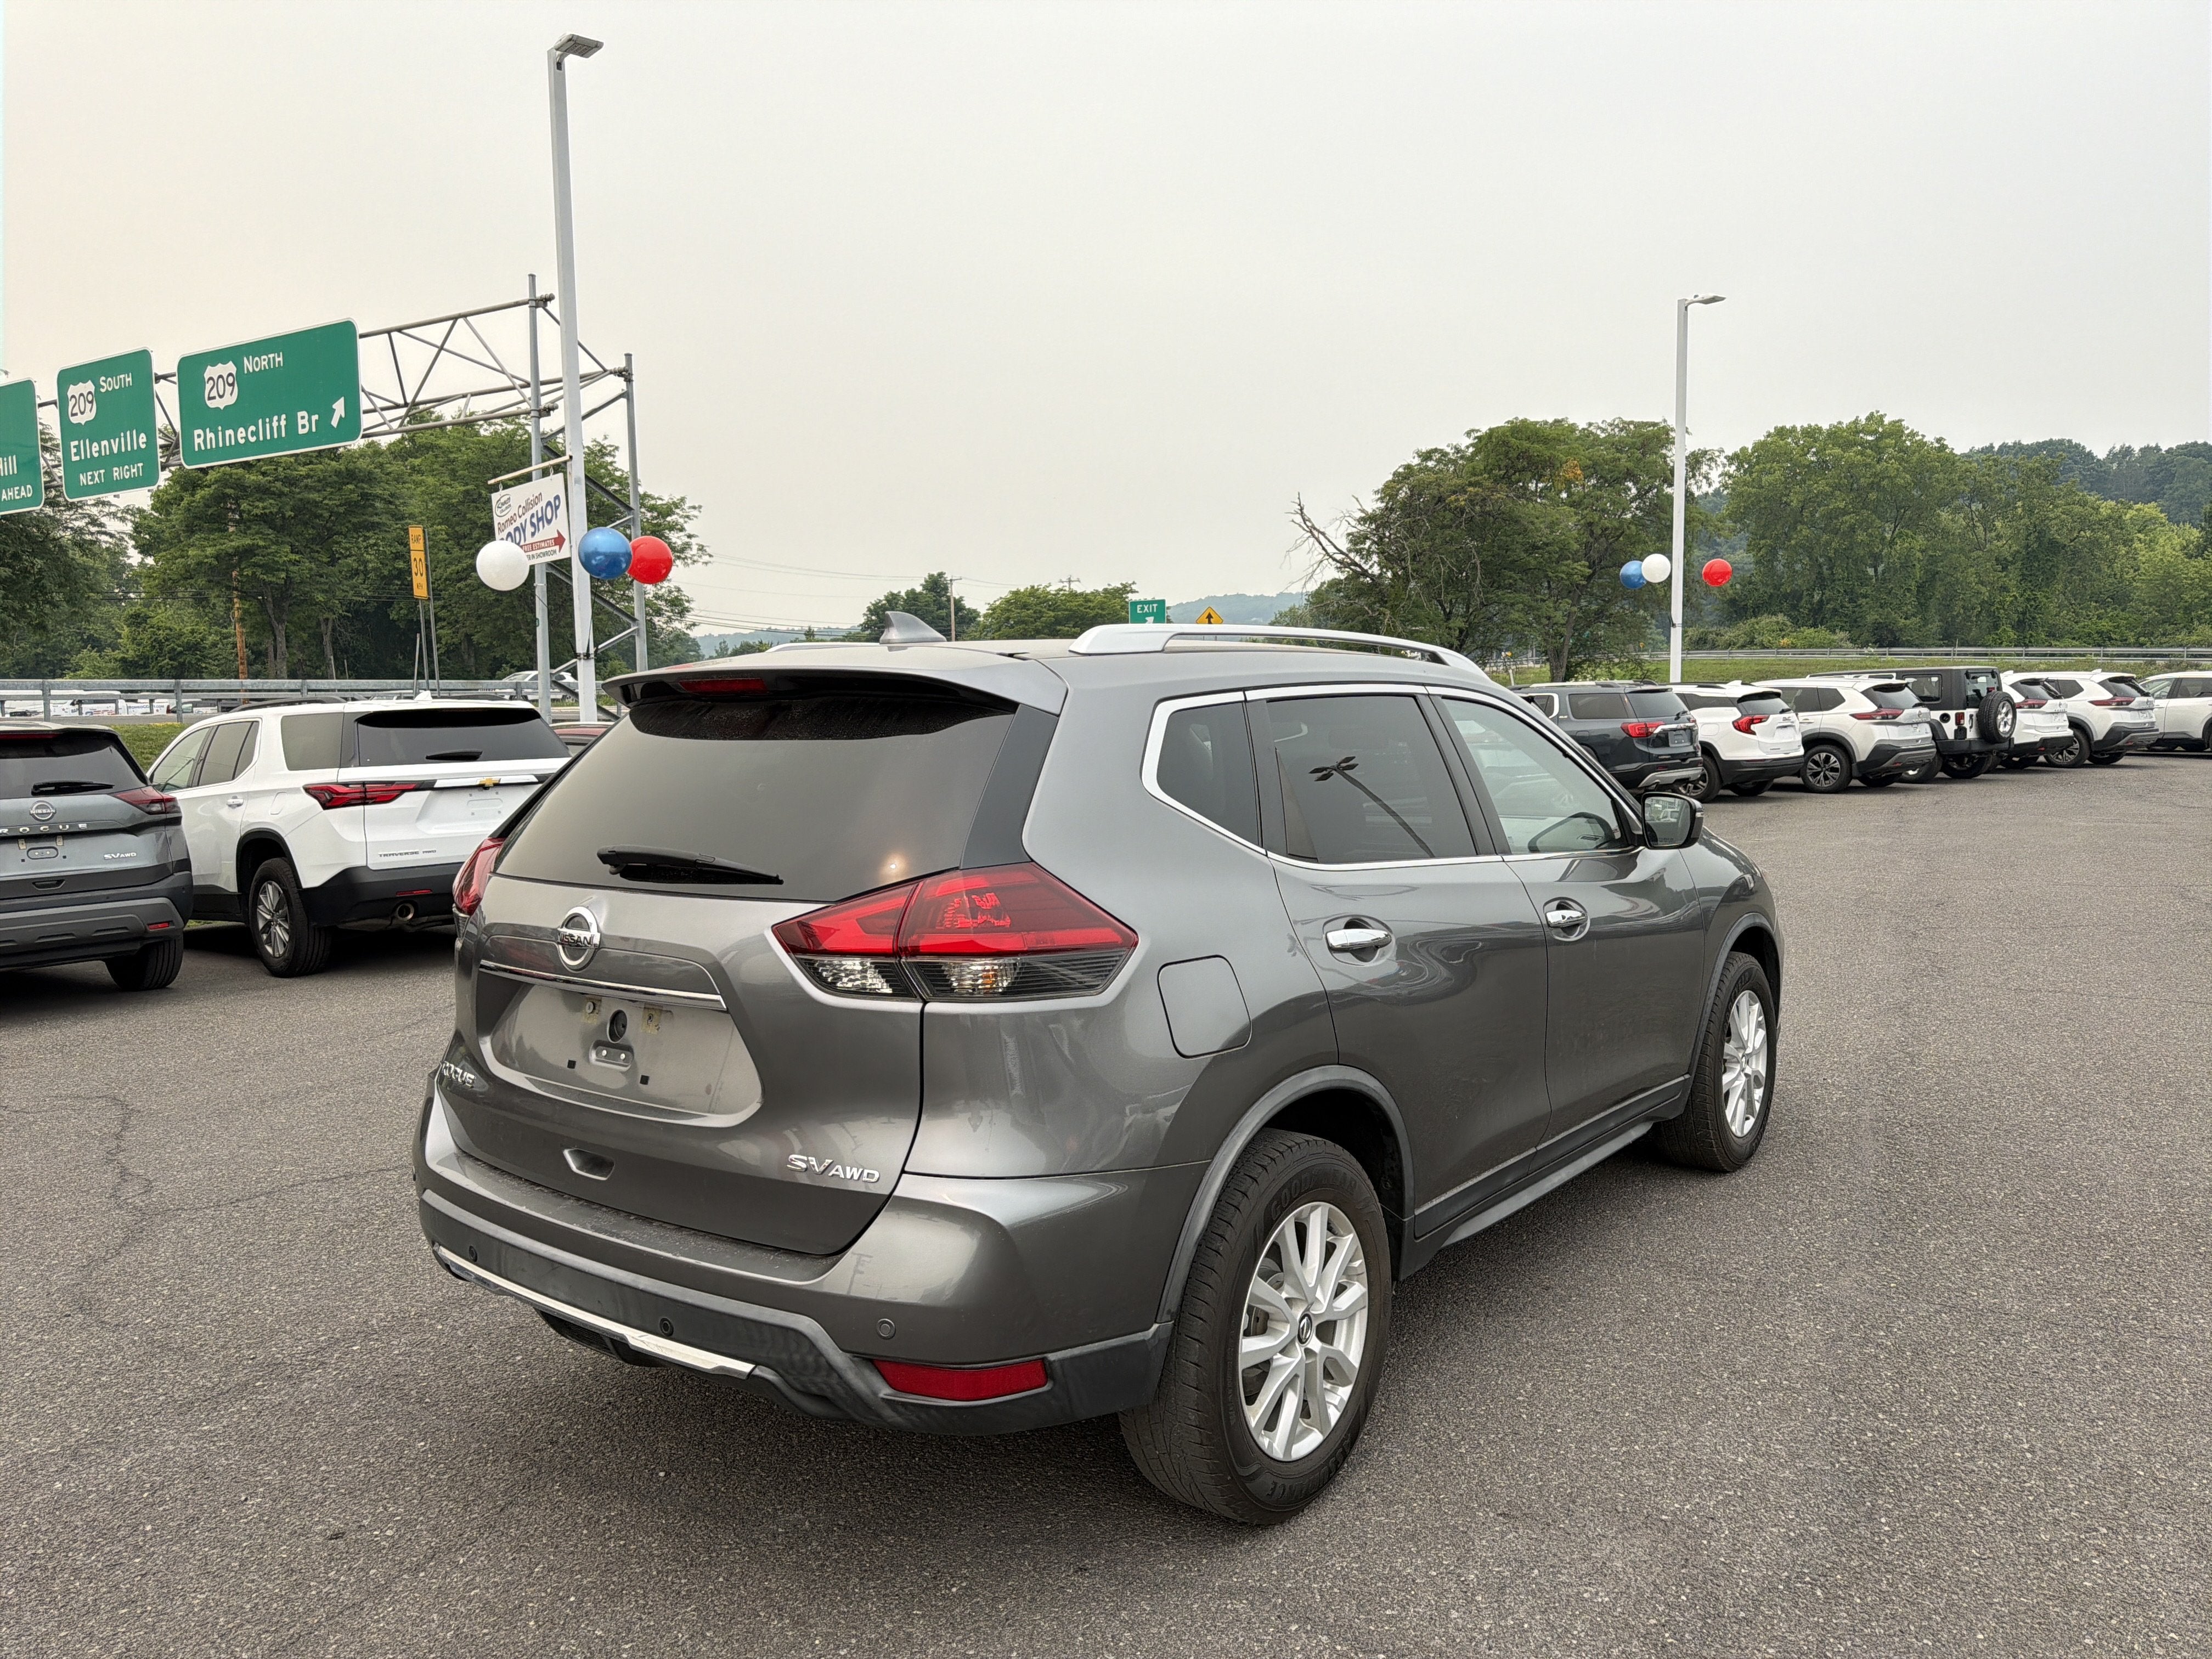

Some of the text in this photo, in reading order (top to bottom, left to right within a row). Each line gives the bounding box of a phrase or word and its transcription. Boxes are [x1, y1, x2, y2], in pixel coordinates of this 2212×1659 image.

[244, 352, 283, 374] NORTH
[99, 373, 132, 393] SOUTH
[206, 372, 236, 401] 209
[69, 390, 94, 417] 209
[194, 410, 318, 452] Rhinecliff Br
[70, 428, 147, 462] Ellenville
[80, 462, 144, 486] NEXT RIGHT
[1, 484, 33, 501] AHEAD
[497, 492, 543, 535] Romeo Collision
[499, 494, 561, 545] ODY SHOP
[533, 539, 555, 550] ESTIMATES
[535, 549, 557, 559] SHOWROOM
[414, 557, 424, 577] 30
[1137, 604, 1158, 613] EXIT
[0, 823, 88, 835] ROGUE
